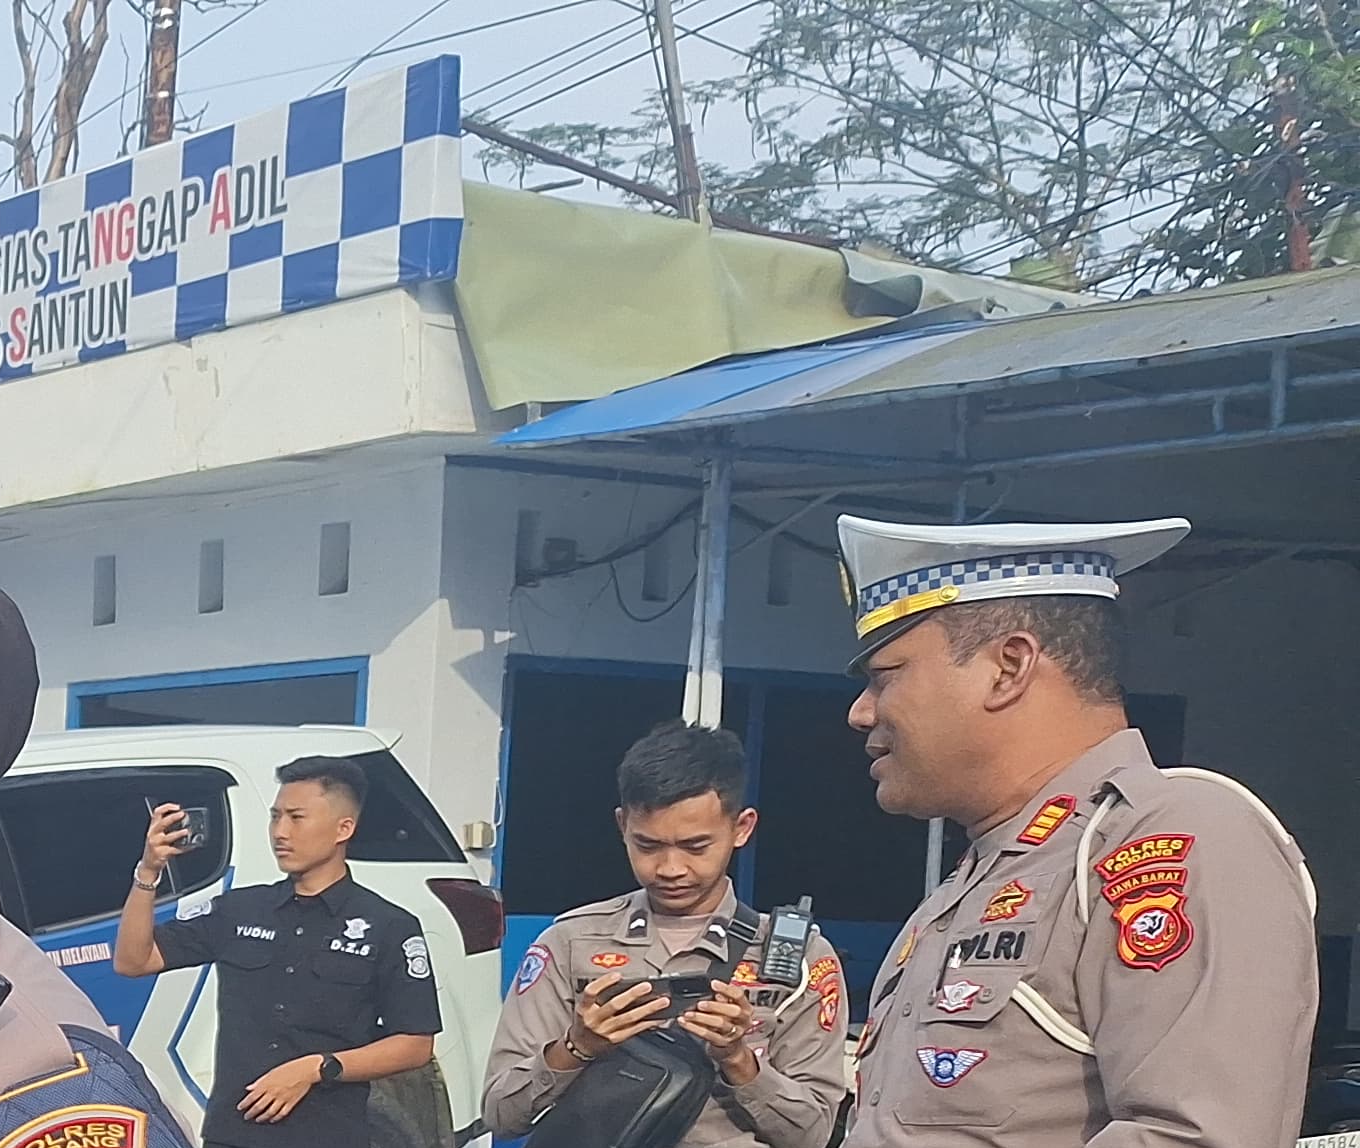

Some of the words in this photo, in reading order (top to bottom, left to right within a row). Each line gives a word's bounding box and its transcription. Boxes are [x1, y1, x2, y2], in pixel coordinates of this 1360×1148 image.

[57, 181, 200, 279] TANGGAP
[208, 154, 288, 236] ADIL
[7, 277, 129, 364] SANTUN
[1104, 839, 1184, 871] POLRES
[1110, 877, 1139, 897] JAWA
[1142, 872, 1180, 885] BARAT
[236, 925, 276, 941] YUDHI
